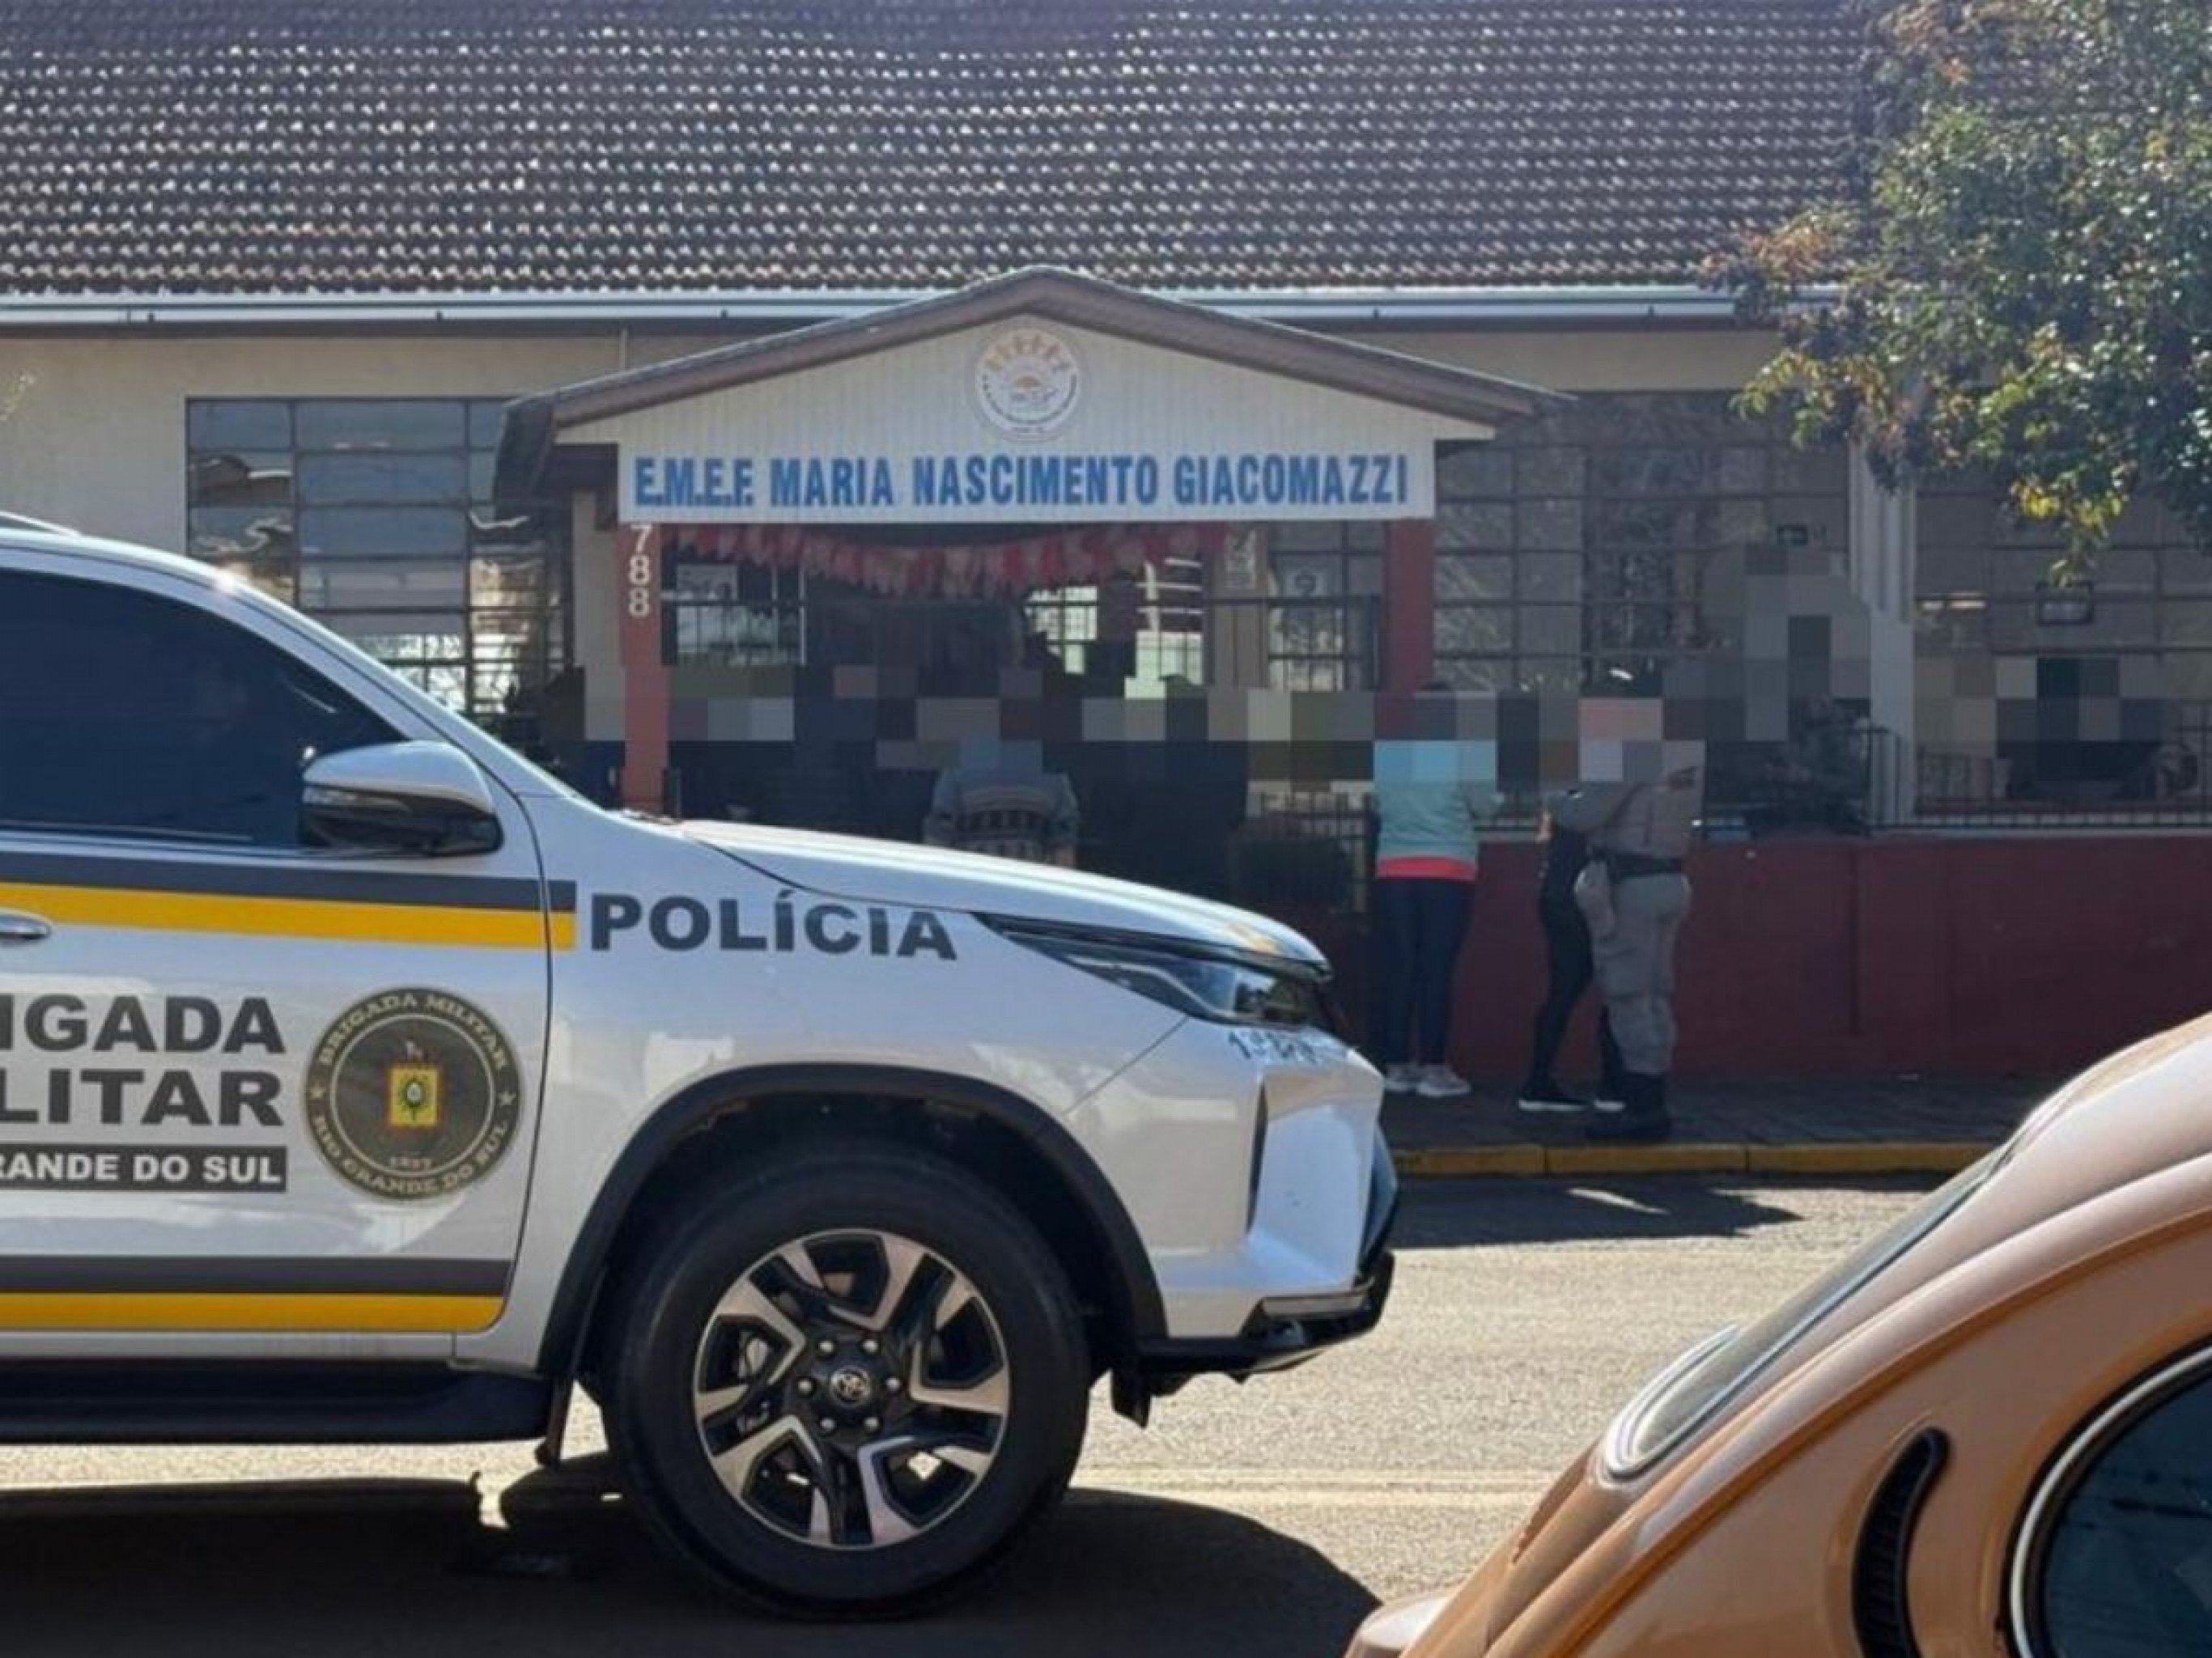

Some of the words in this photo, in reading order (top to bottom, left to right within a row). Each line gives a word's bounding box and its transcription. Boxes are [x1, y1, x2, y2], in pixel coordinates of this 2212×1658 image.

[635, 457, 754, 507] E.M.E.F.
[770, 457, 894, 507] MARIA
[913, 455, 1157, 506] NASCIMENTO
[1174, 455, 1407, 506] GIACOMAZZI
[629, 524, 651, 617] 788
[591, 890, 957, 960] POLÍCIA
[319, 993, 418, 1065] BRIGADA
[426, 994, 507, 1071] MILITAR
[0, 1152, 120, 1181] ANDE
[133, 1154, 189, 1182] DO
[203, 1156, 281, 1184] SUL
[313, 1117, 341, 1158] RIO
[342, 1158, 439, 1194] GRANDE
[443, 1163, 474, 1189] DO
[474, 1123, 507, 1165] SUL
